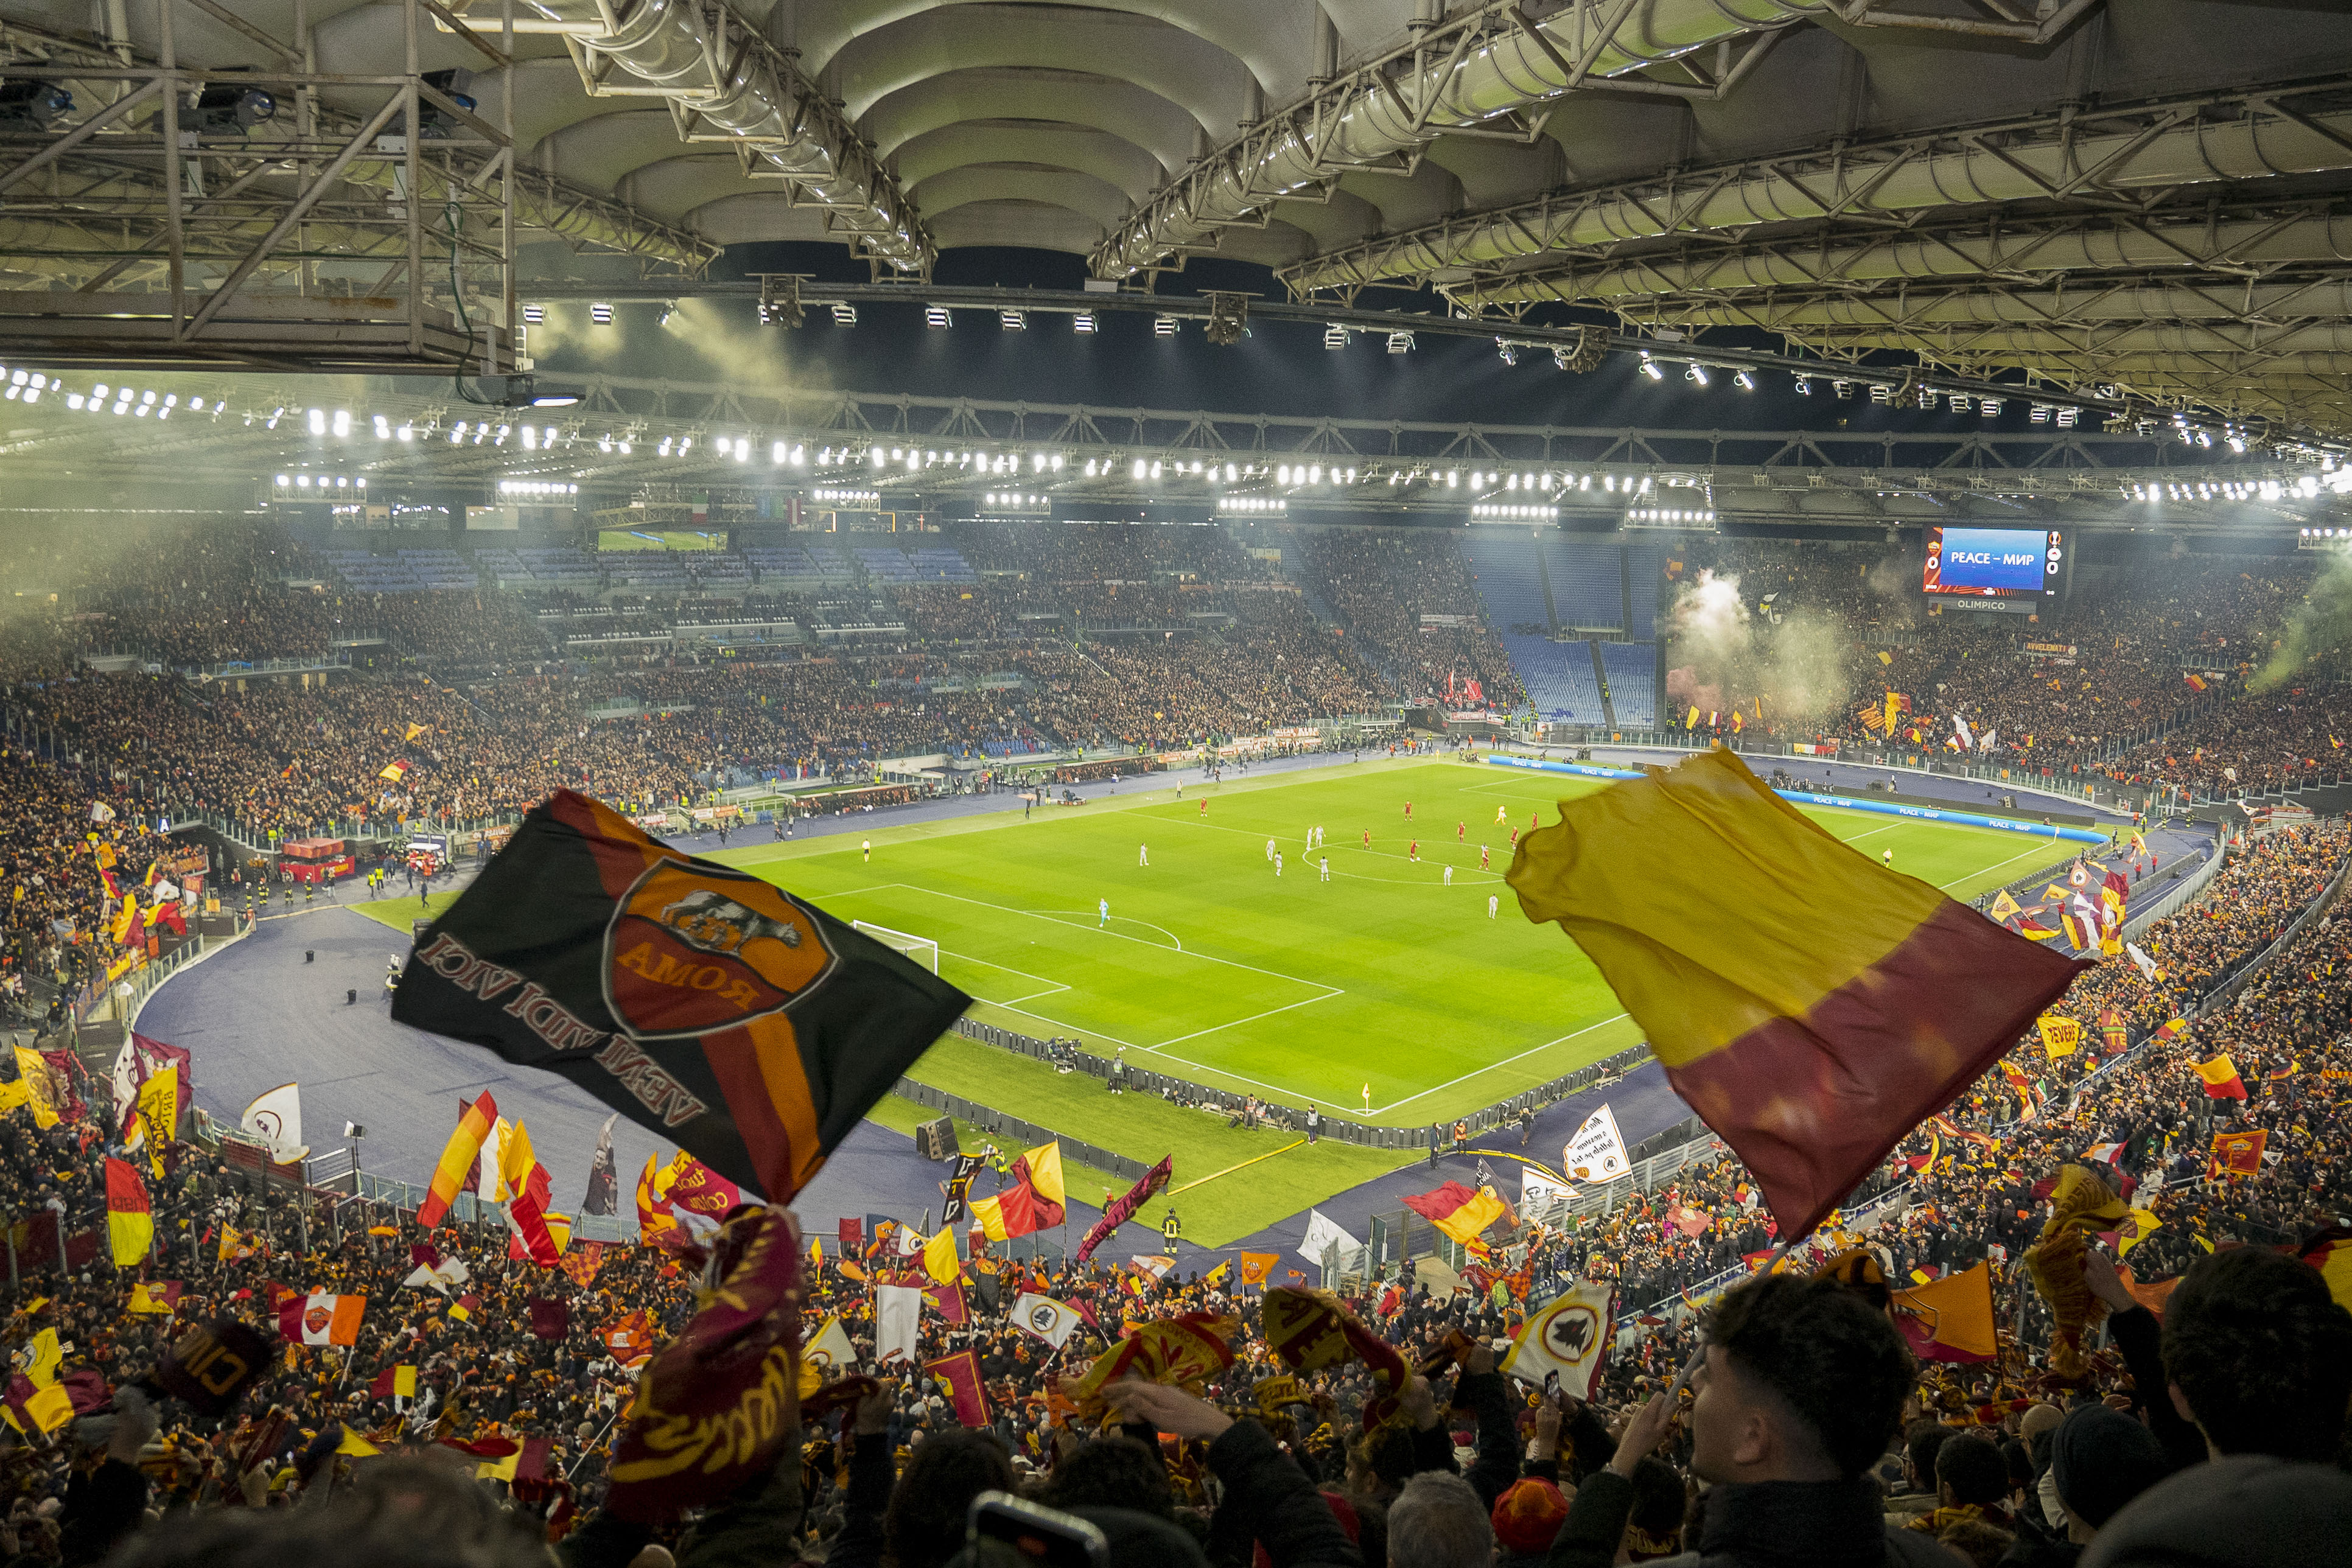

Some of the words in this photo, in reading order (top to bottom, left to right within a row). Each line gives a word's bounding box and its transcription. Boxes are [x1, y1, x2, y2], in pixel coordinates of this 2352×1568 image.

[1928, 556, 1939, 569] 0
[1951, 551, 1990, 564] PEACE
[2003, 553, 2034, 566] МИР
[2046, 561, 2059, 575] 0
[1957, 600, 2006, 610] OLIMPICO
[2027, 642, 2067, 652] AVVELENATI
[1813, 796, 1832, 805] PEACE
[1899, 808, 1919, 816] PEACE
[159, 818, 169, 832] A
[1989, 820, 2009, 828] PEACE
[2109, 1012, 2121, 1026] A
[2048, 1024, 2076, 1043] TEVERE
